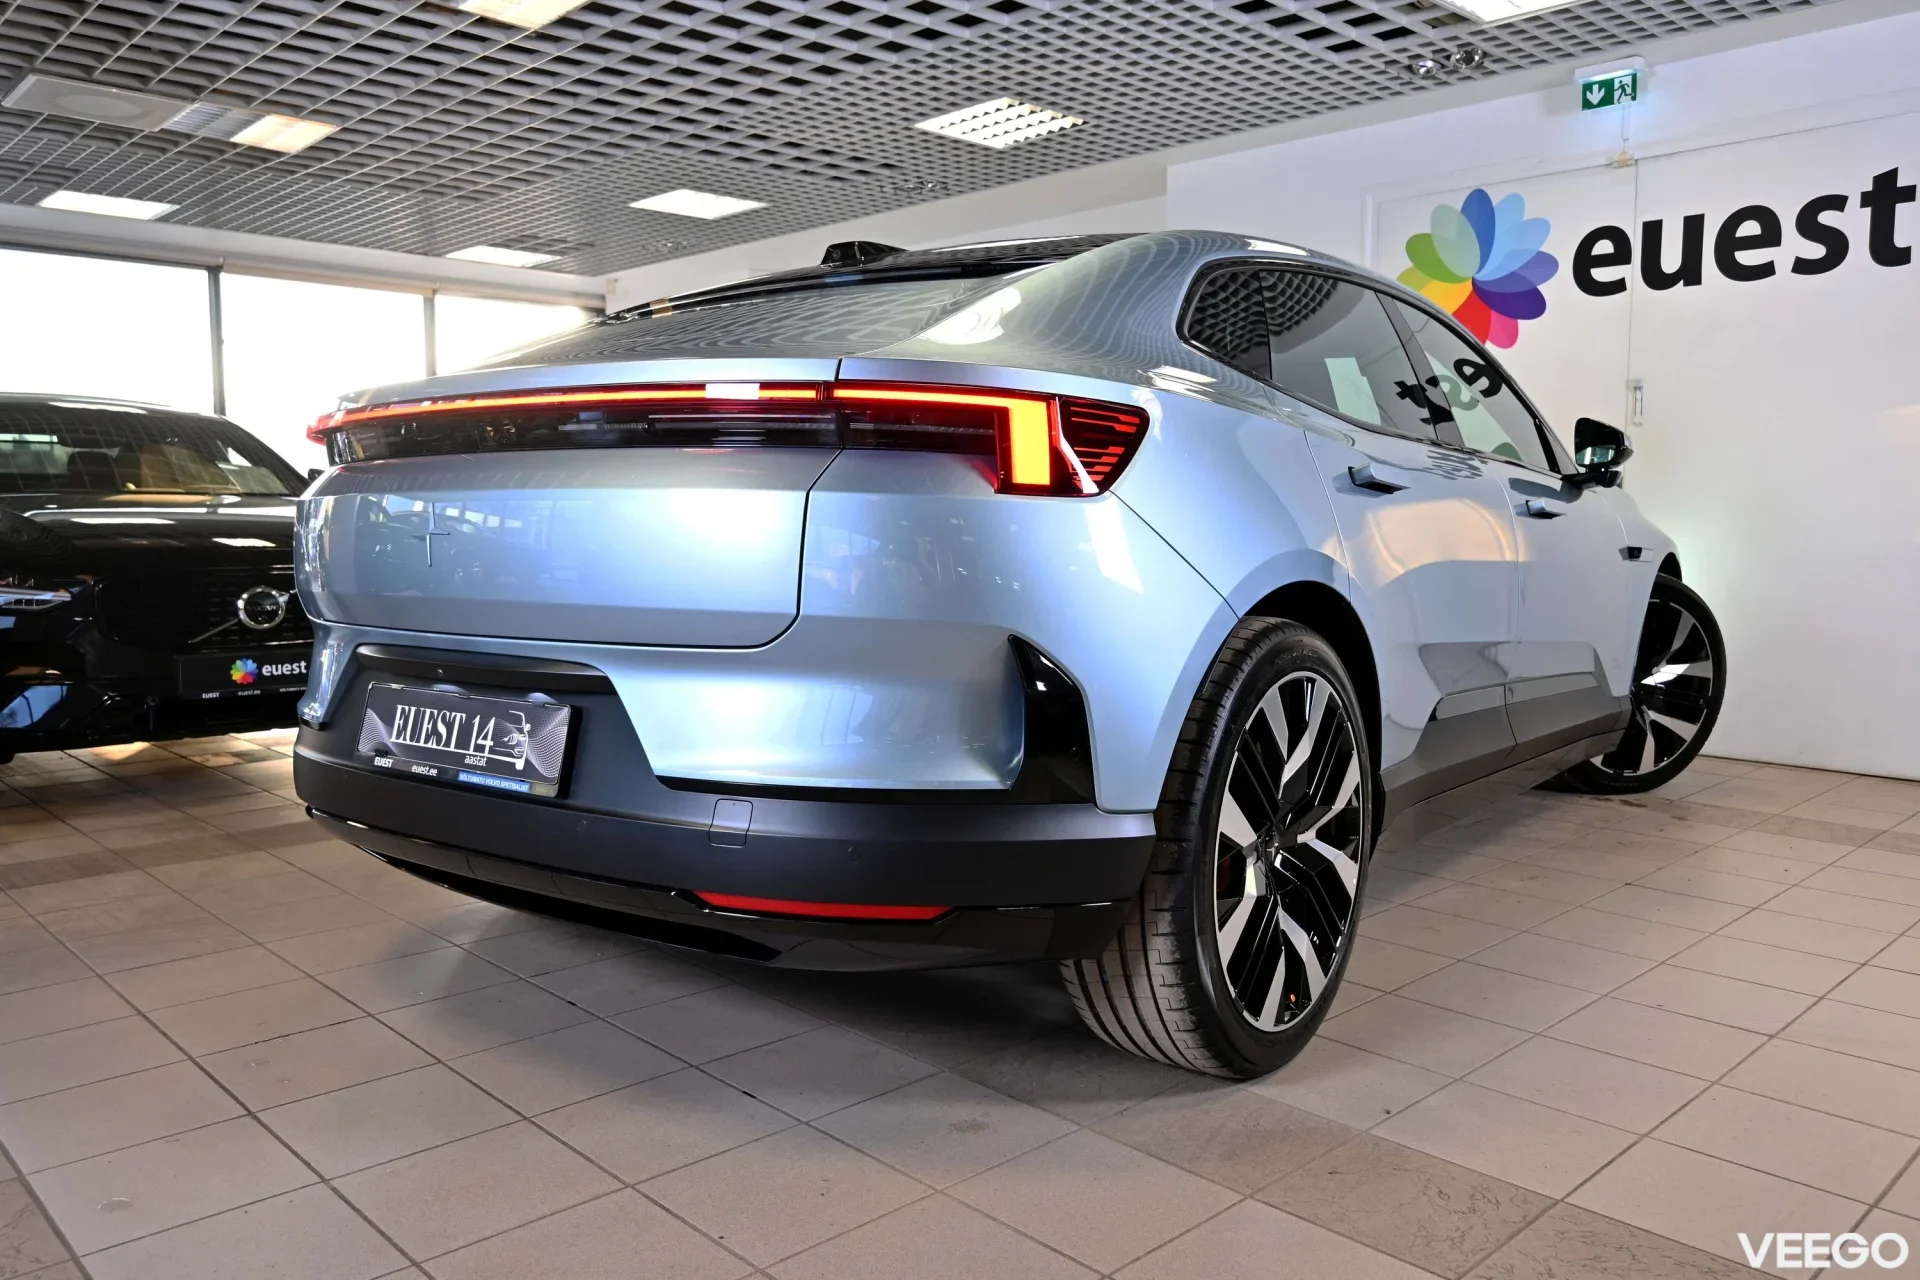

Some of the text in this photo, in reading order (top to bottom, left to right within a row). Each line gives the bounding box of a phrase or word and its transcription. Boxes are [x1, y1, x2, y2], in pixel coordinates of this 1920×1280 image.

[1572, 166, 1917, 298] euest
[262, 661, 307, 676] euest
[238, 689, 261, 697] euest.ee
[390, 704, 496, 754] EUEST 14
[374, 756, 394, 768] EUEST
[464, 754, 488, 767] aastat
[411, 764, 438, 777] euest.ee
[485, 778, 501, 787] VOLVO
